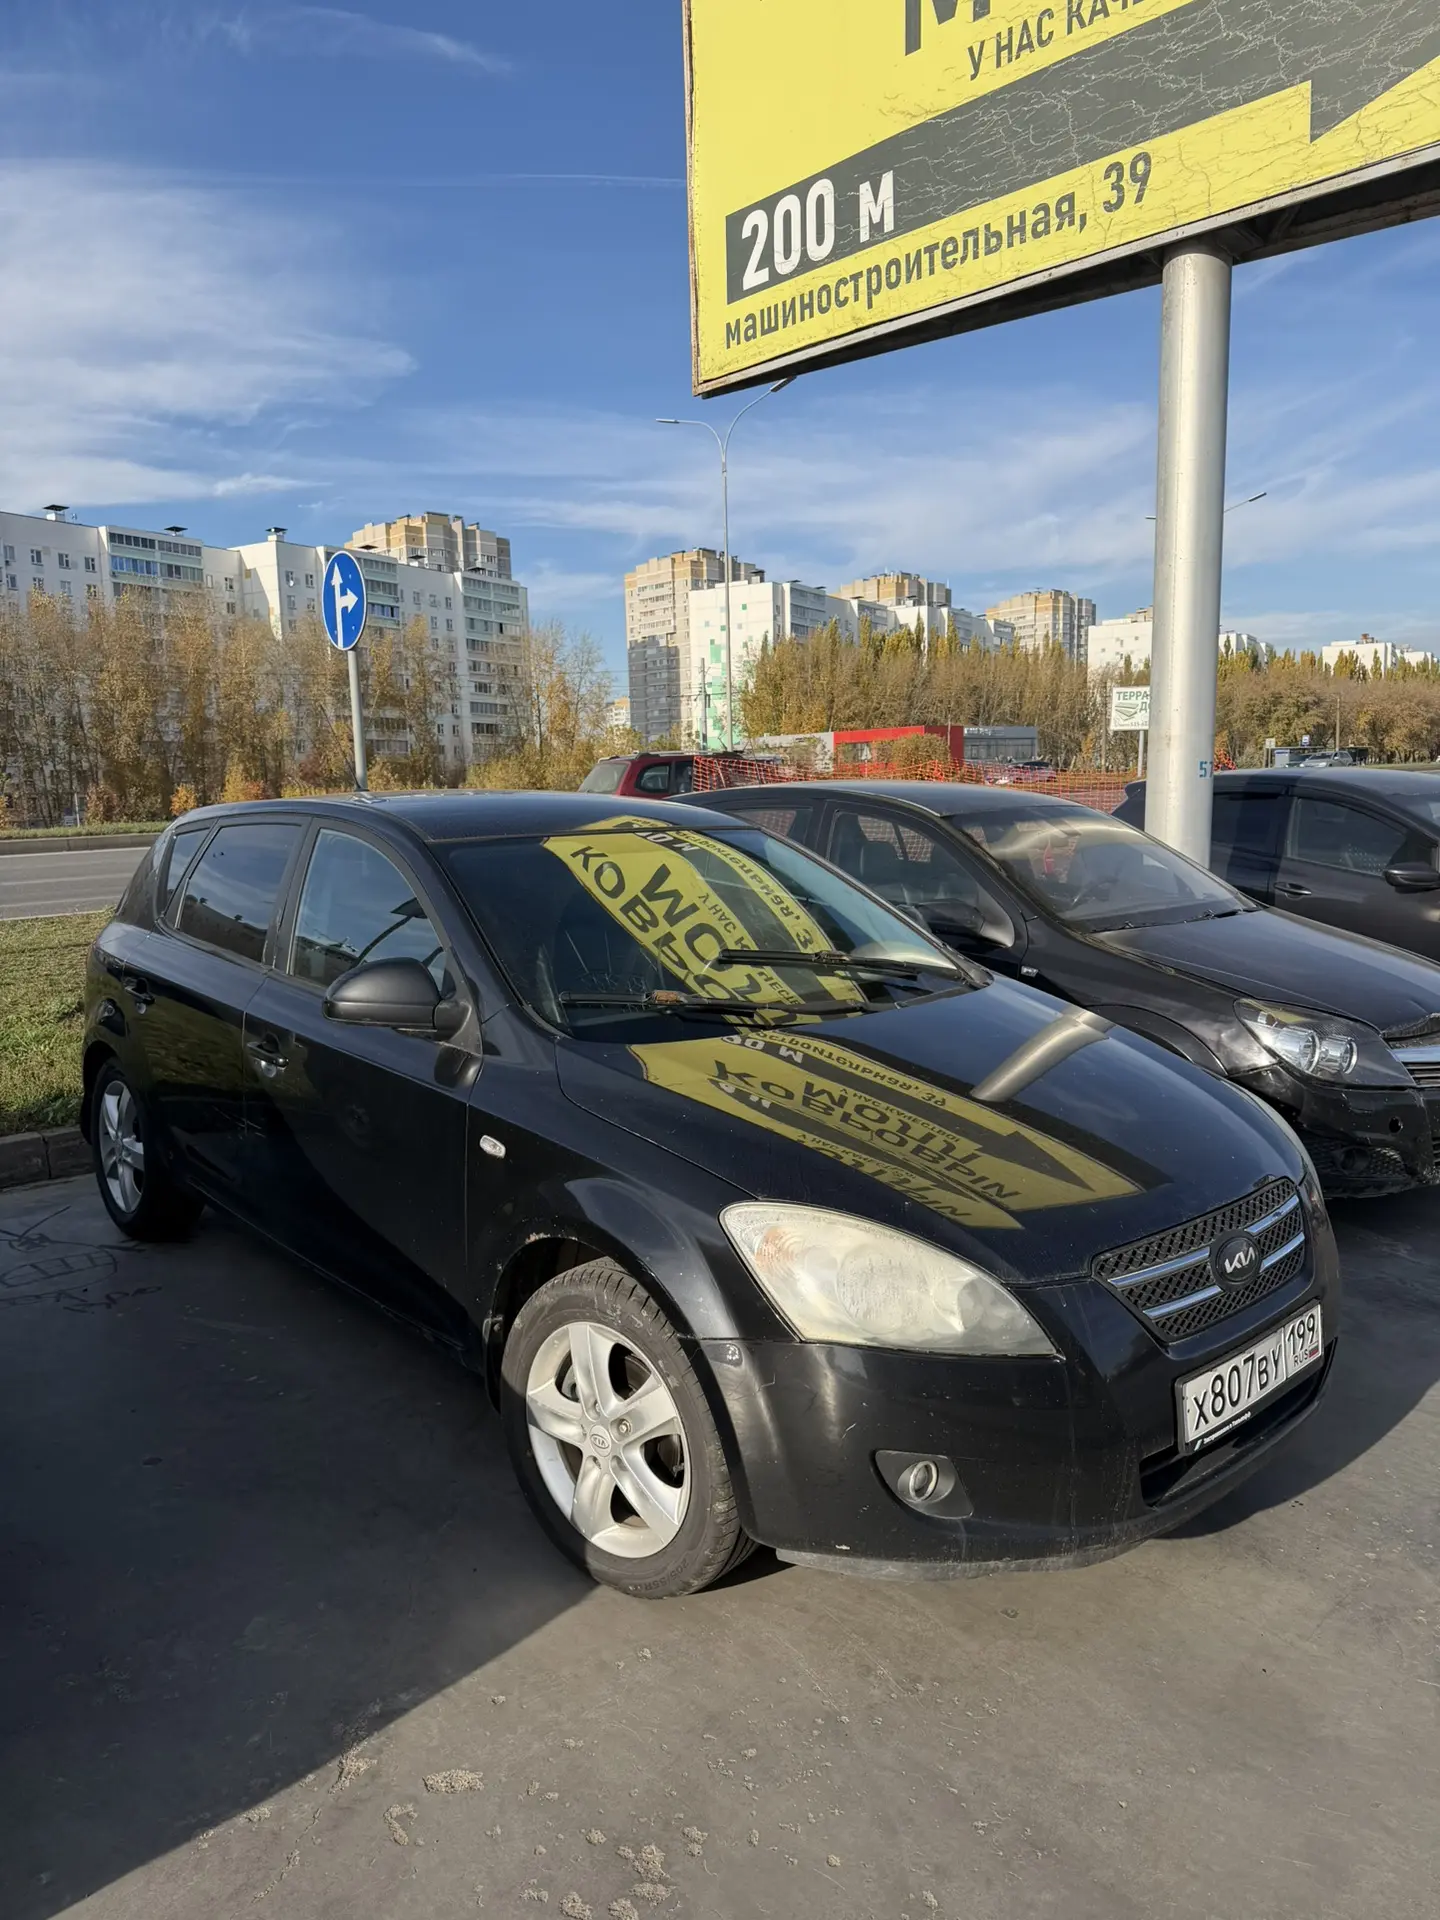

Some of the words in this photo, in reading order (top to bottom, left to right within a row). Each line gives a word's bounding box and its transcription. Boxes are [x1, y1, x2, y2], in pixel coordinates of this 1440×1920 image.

[994, 8, 1054, 69] НАС
[726, 191, 1087, 350] машиностроительная,
[1102, 151, 1152, 213] 39
[741, 178, 835, 291] 200
[1286, 1313, 1316, 1355] 199
[1293, 1352, 1309, 1368] RUS
